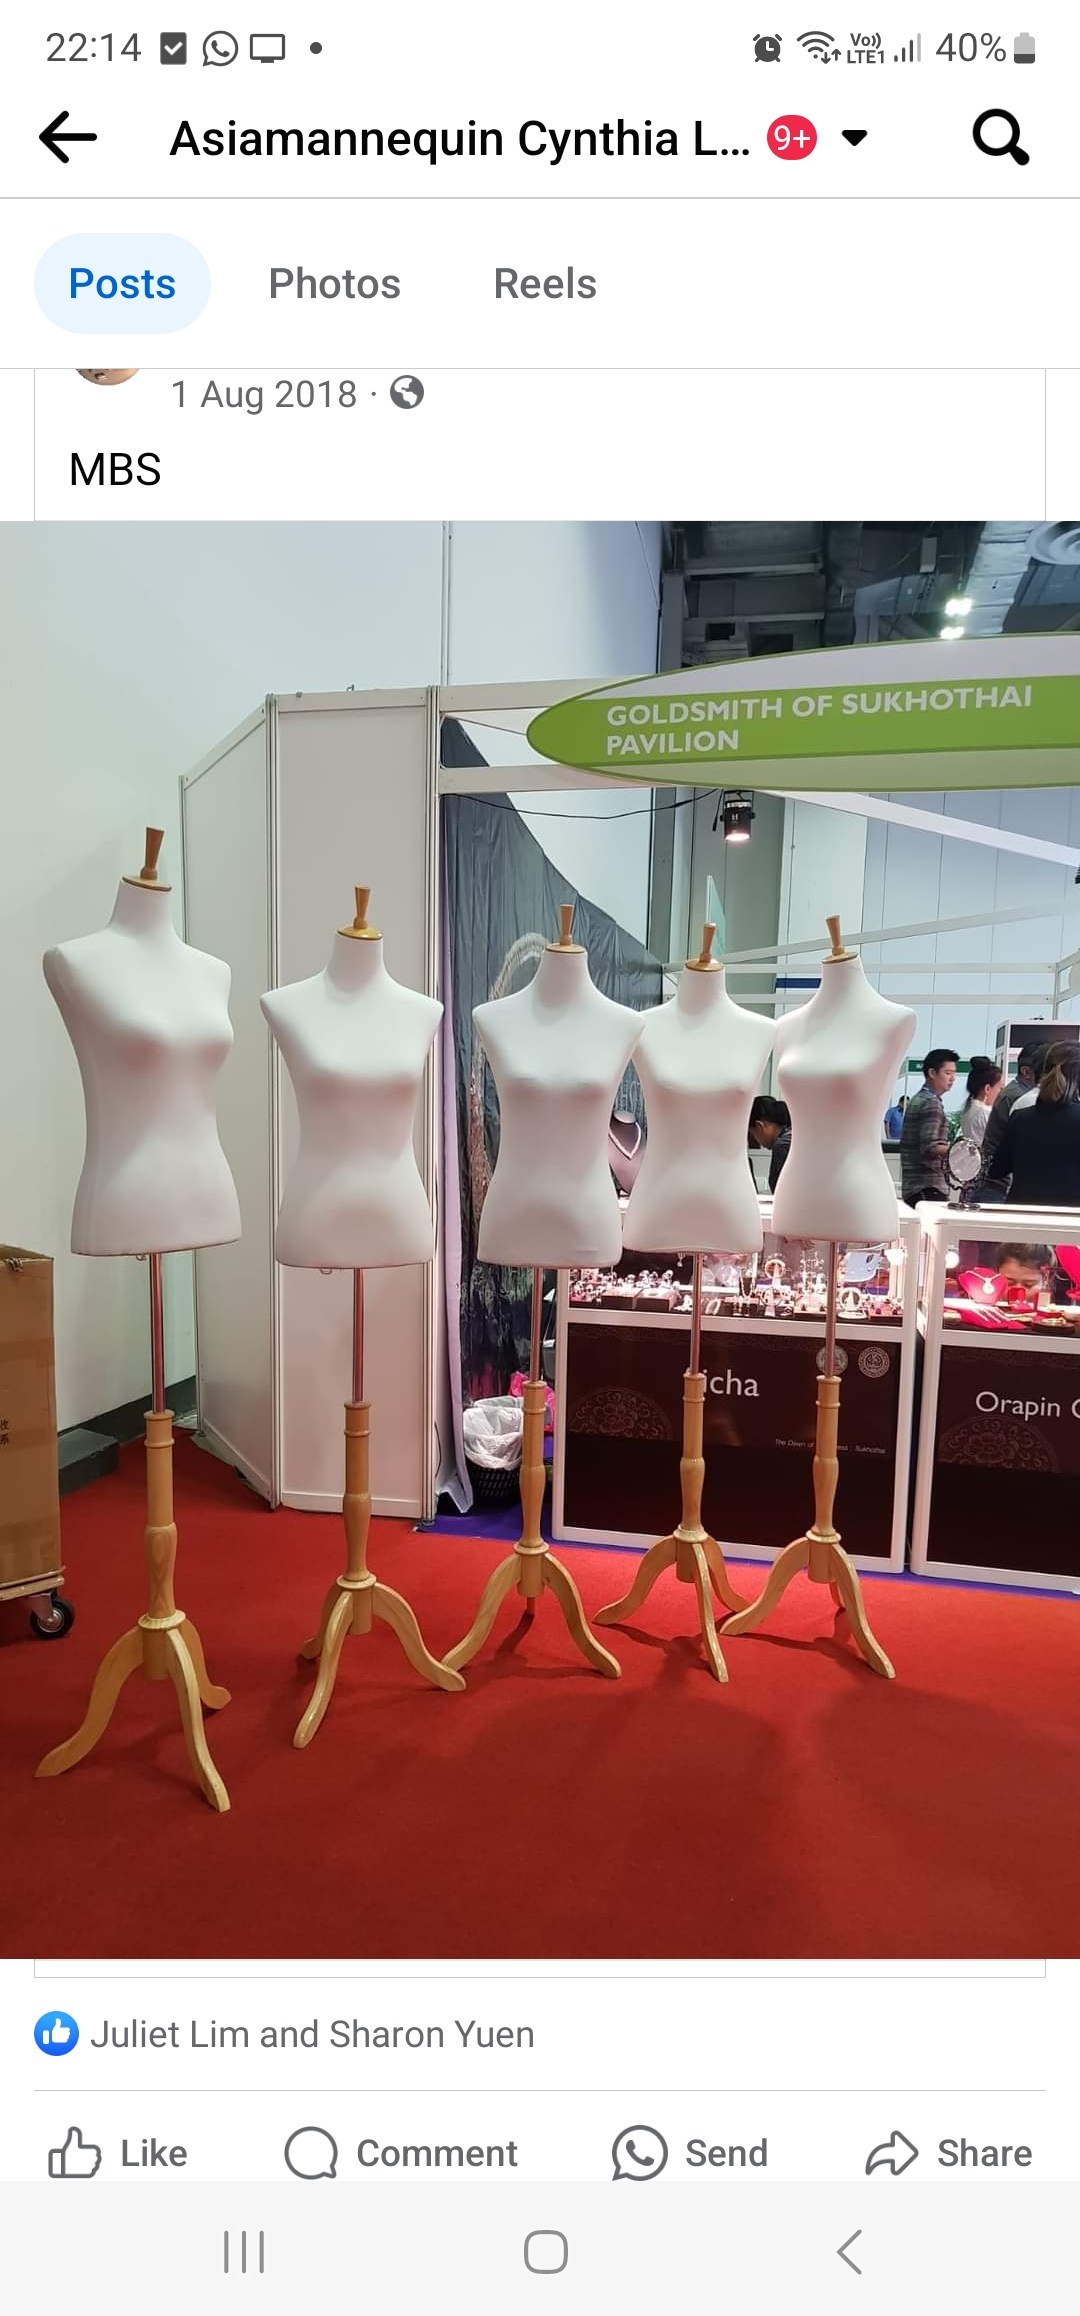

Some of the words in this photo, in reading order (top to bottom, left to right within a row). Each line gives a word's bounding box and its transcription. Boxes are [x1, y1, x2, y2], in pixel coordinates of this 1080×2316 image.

[46, 32, 142, 62] 22:14
[846, 48, 886, 64] LTE1
[935, 32, 1007, 62] 40%
[168, 119, 503, 166] Asiamannequin
[518, 118, 679, 166] Cynthia
[773, 125, 812, 151] 9+
[70, 267, 176, 300] Posts
[269, 266, 401, 300] Photos
[494, 266, 597, 300] Reels
[172, 380, 184, 408] 1
[200, 380, 263, 416] Aug
[275, 379, 357, 408] 2018
[70, 452, 161, 487] MBS
[606, 698, 783, 727] GOLDSMITH
[791, 694, 833, 717] OF
[841, 684, 1032, 715] SUKHOTHAI
[606, 729, 739, 756] PAVILION
[685, 1367, 760, 1397] icha
[975, 1391, 1061, 1422] Orapin
[91, 2018, 180, 2048] Juliet
[191, 2018, 249, 2048] Lim
[260, 2018, 318, 2048] and
[330, 2018, 444, 2048] Sharon
[454, 2019, 534, 2048] Yuen
[121, 2137, 188, 2167] Like
[356, 2137, 519, 2167] Comment
[685, 2137, 768, 2167] Send
[937, 2137, 1033, 2167] Share
